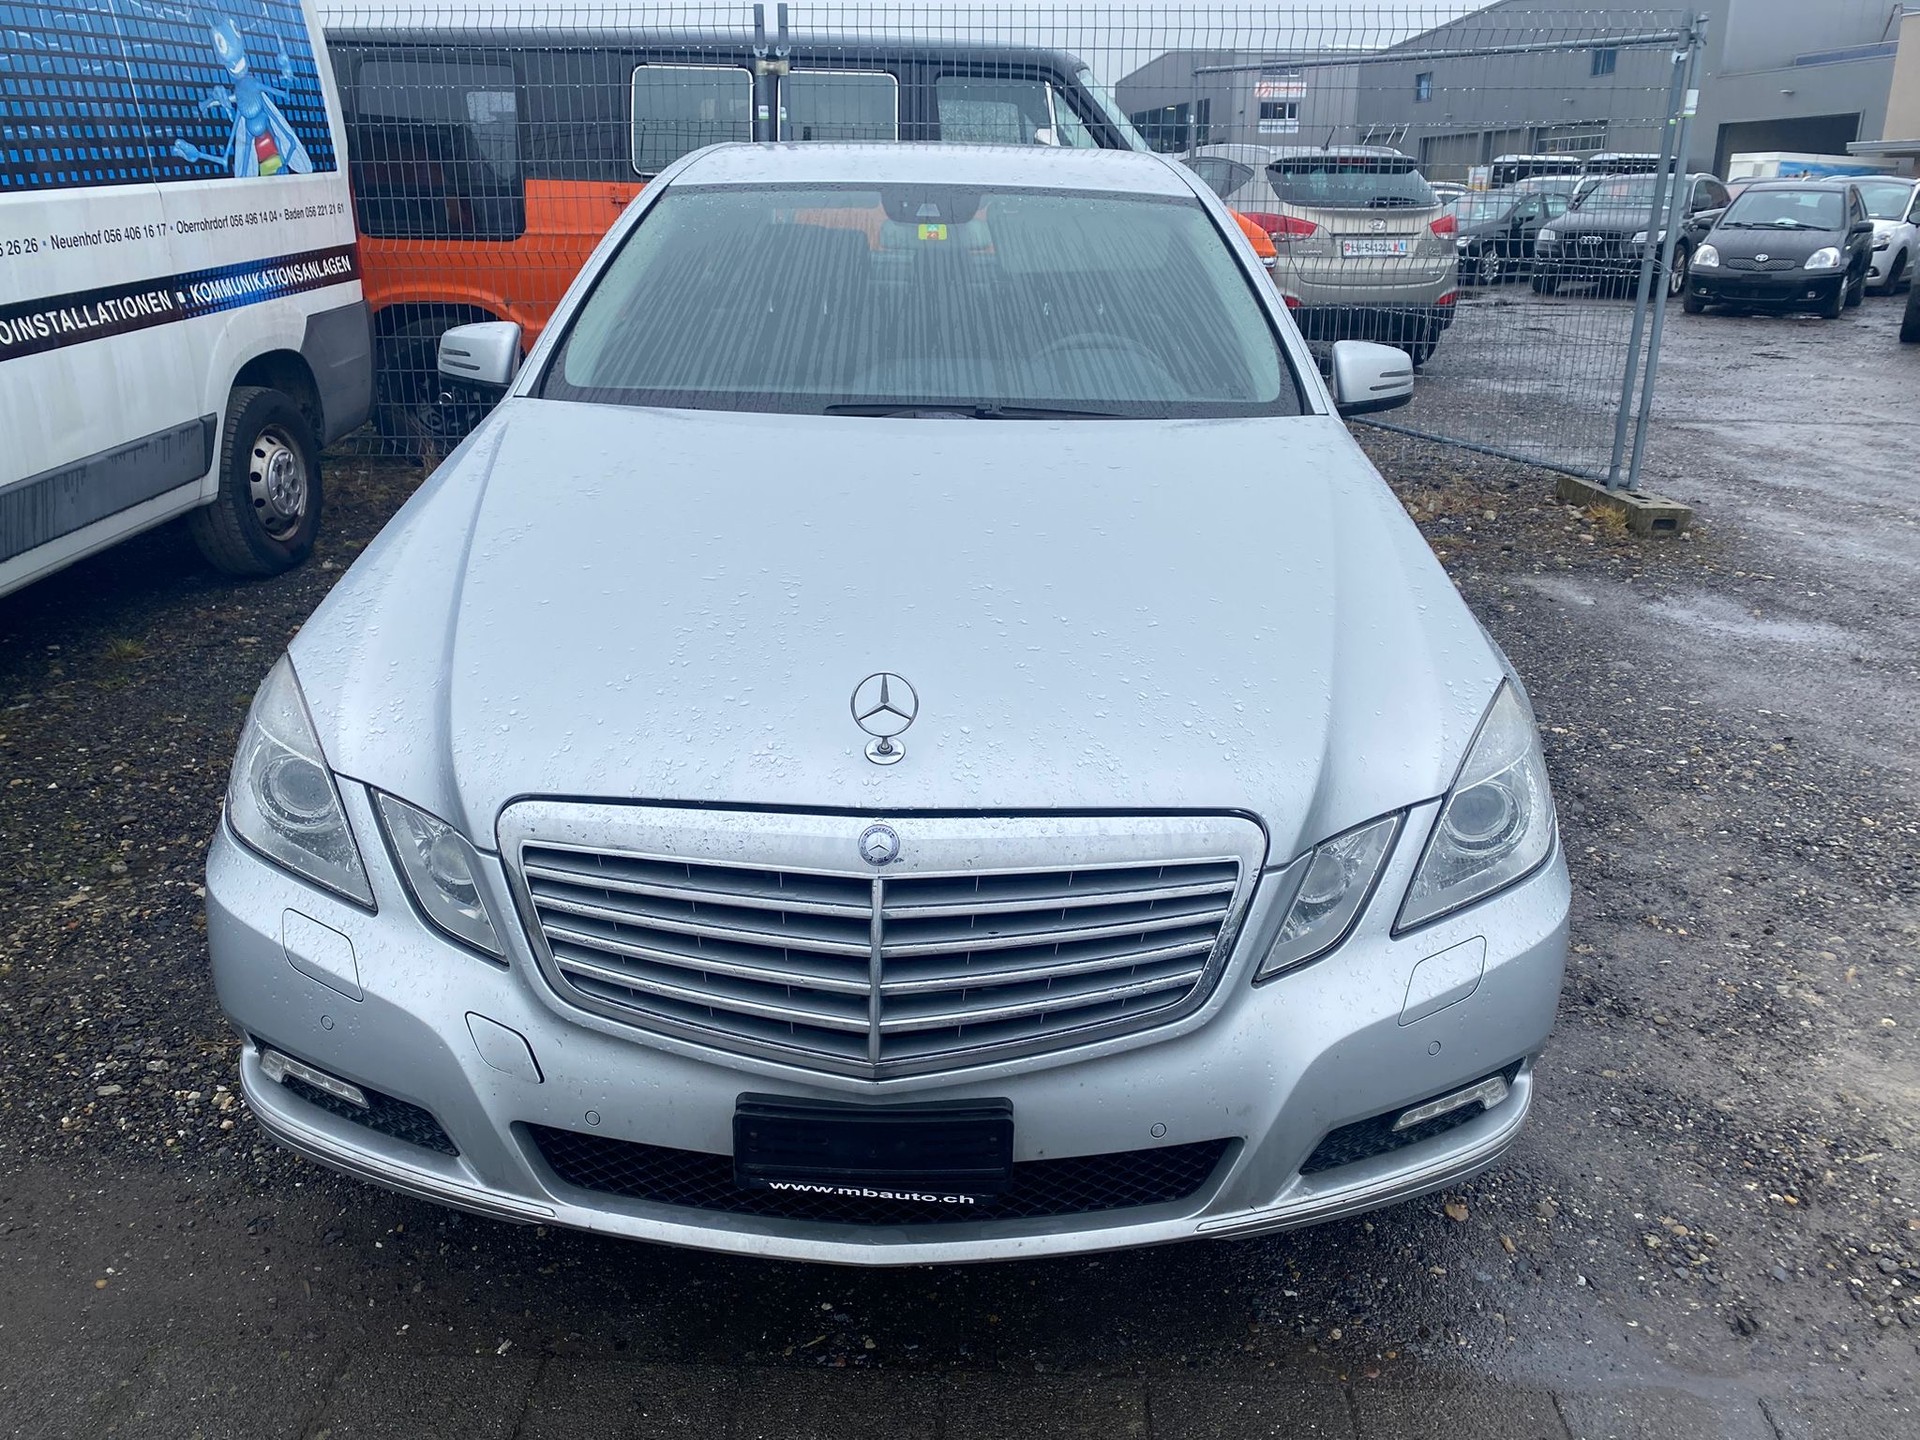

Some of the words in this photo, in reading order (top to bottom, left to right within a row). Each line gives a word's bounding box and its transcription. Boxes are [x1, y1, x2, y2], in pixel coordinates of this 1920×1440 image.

[6, 239, 21, 256] 26
[23, 237, 39, 254] 26
[50, 229, 102, 250] Neuenhof
[103, 228, 122, 244] 056
[124, 226, 141, 241] 406
[143, 224, 155, 238] 16
[156, 223, 167, 237] 17
[176, 215, 229, 235] Oberrohrdorf
[230, 214, 244, 228] 056
[245, 212, 259, 226] 496
[259, 211, 268, 224] 14
[269, 210, 278, 223] 04
[284, 207, 305, 221] Baden
[305, 205, 317, 219] 056
[317, 204, 328, 217] 221
[329, 203, 336, 215] 21
[337, 202, 345, 214] 61
[189, 255, 352, 305] KOMMUNIKATIONSANLAGEN
[769, 1182, 975, 1204] www.mbauto.ch
